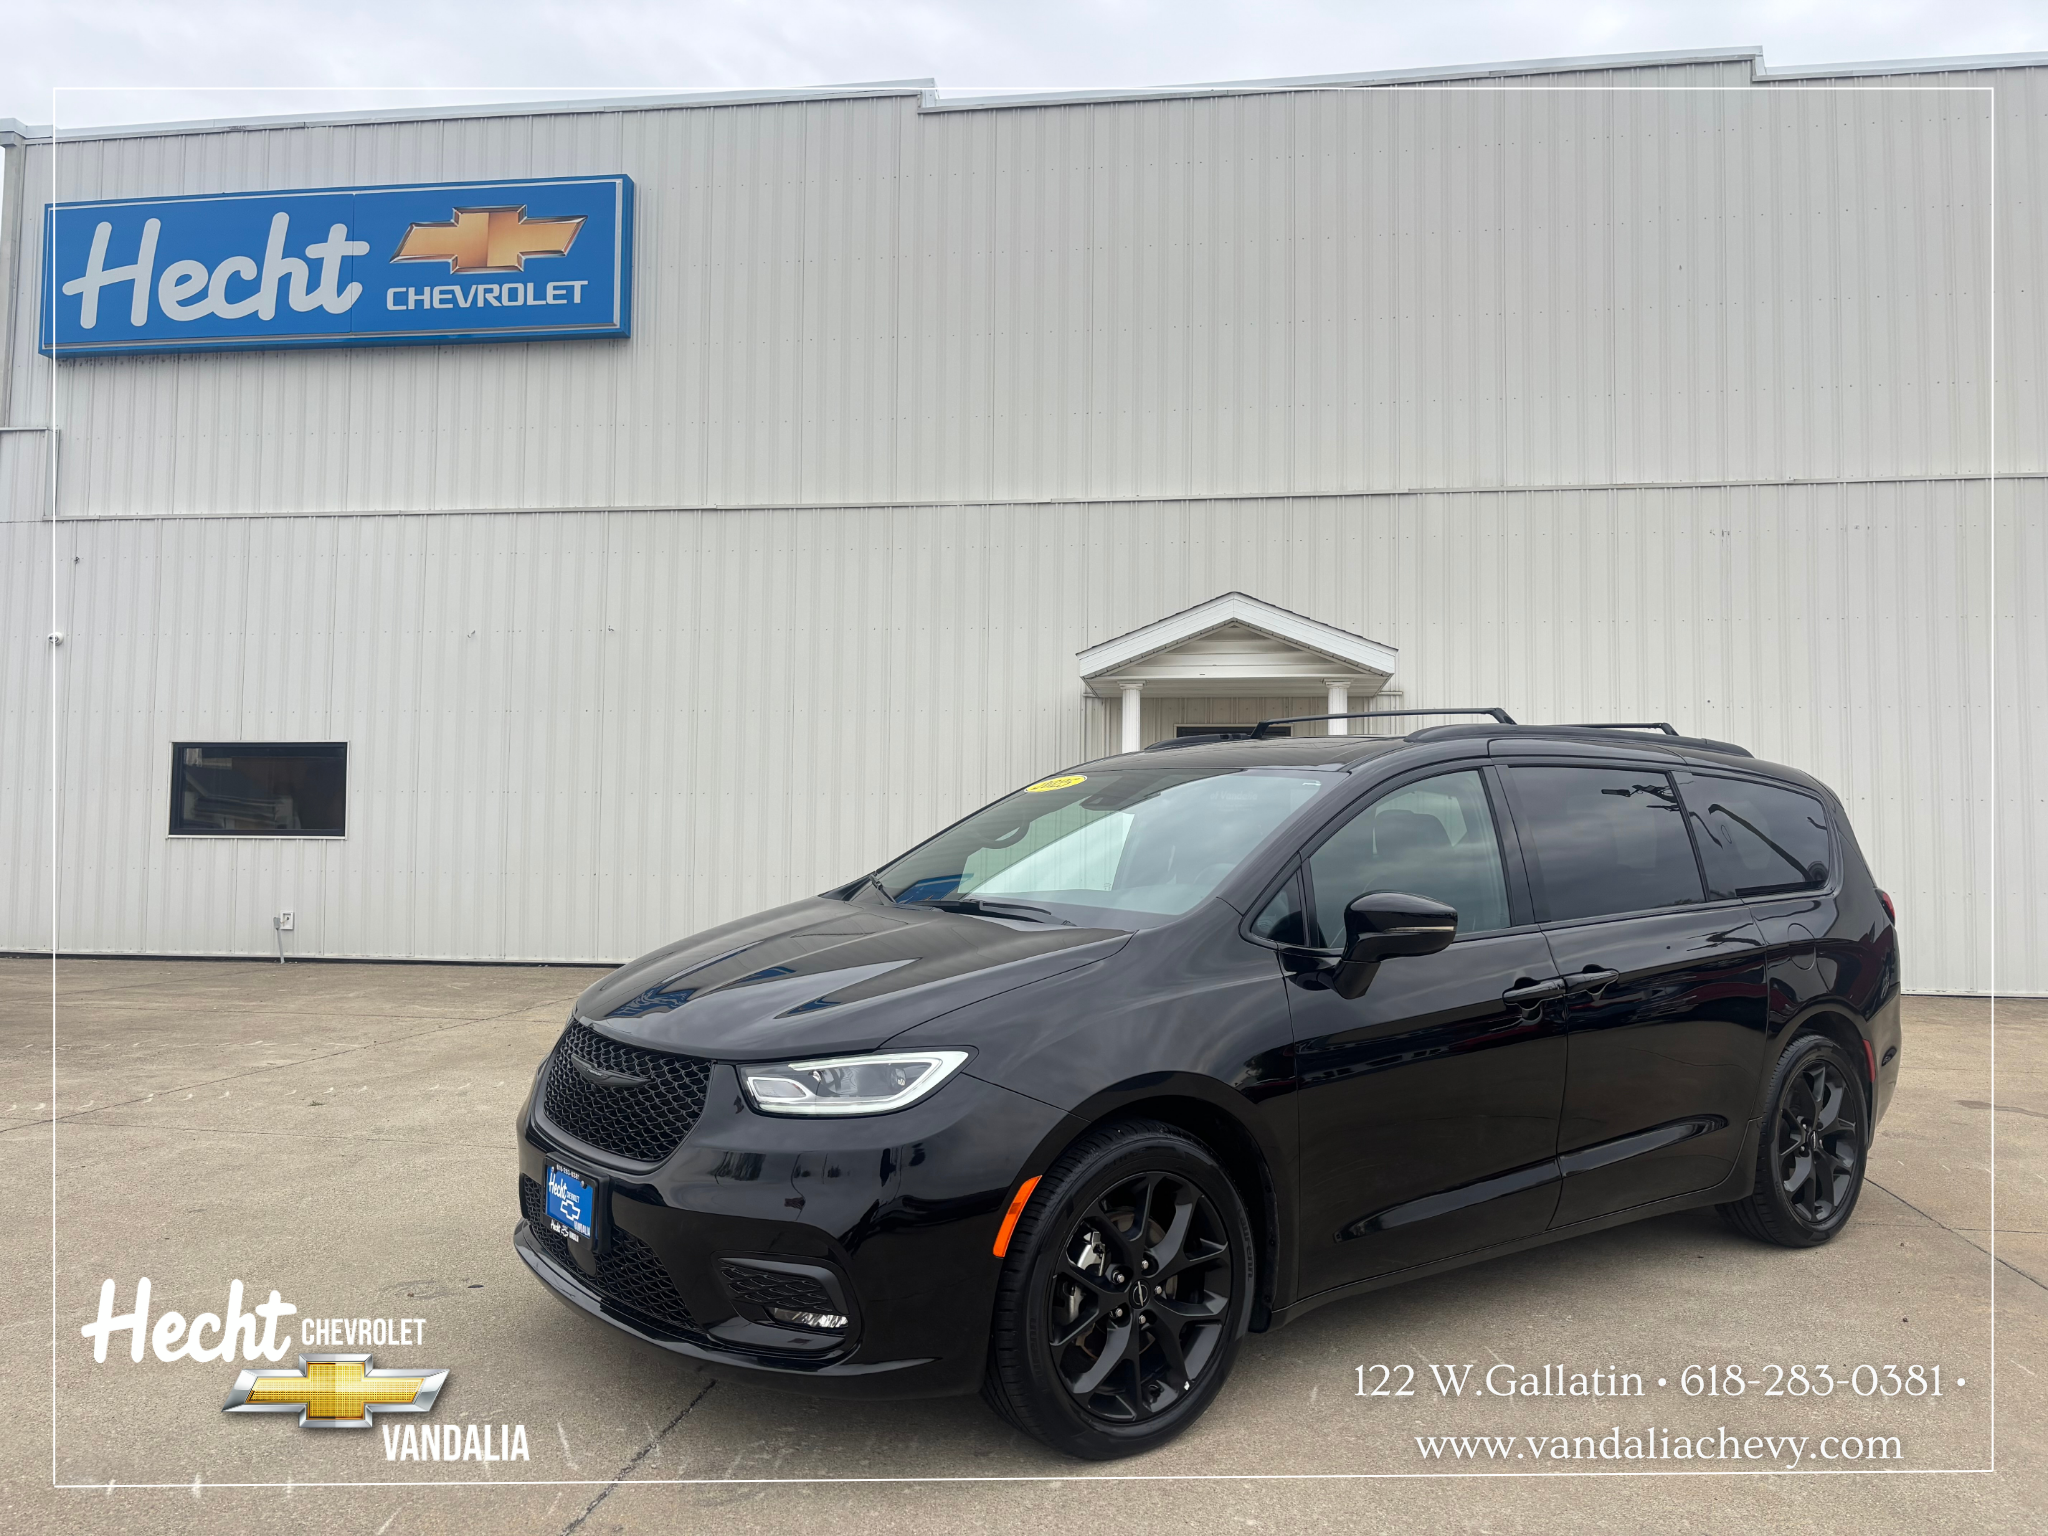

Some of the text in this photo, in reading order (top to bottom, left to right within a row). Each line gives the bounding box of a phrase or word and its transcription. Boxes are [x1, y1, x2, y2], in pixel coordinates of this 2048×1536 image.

[62, 211, 589, 330] Hecht CHEVROLET
[548, 1172, 567, 1200] Hecht
